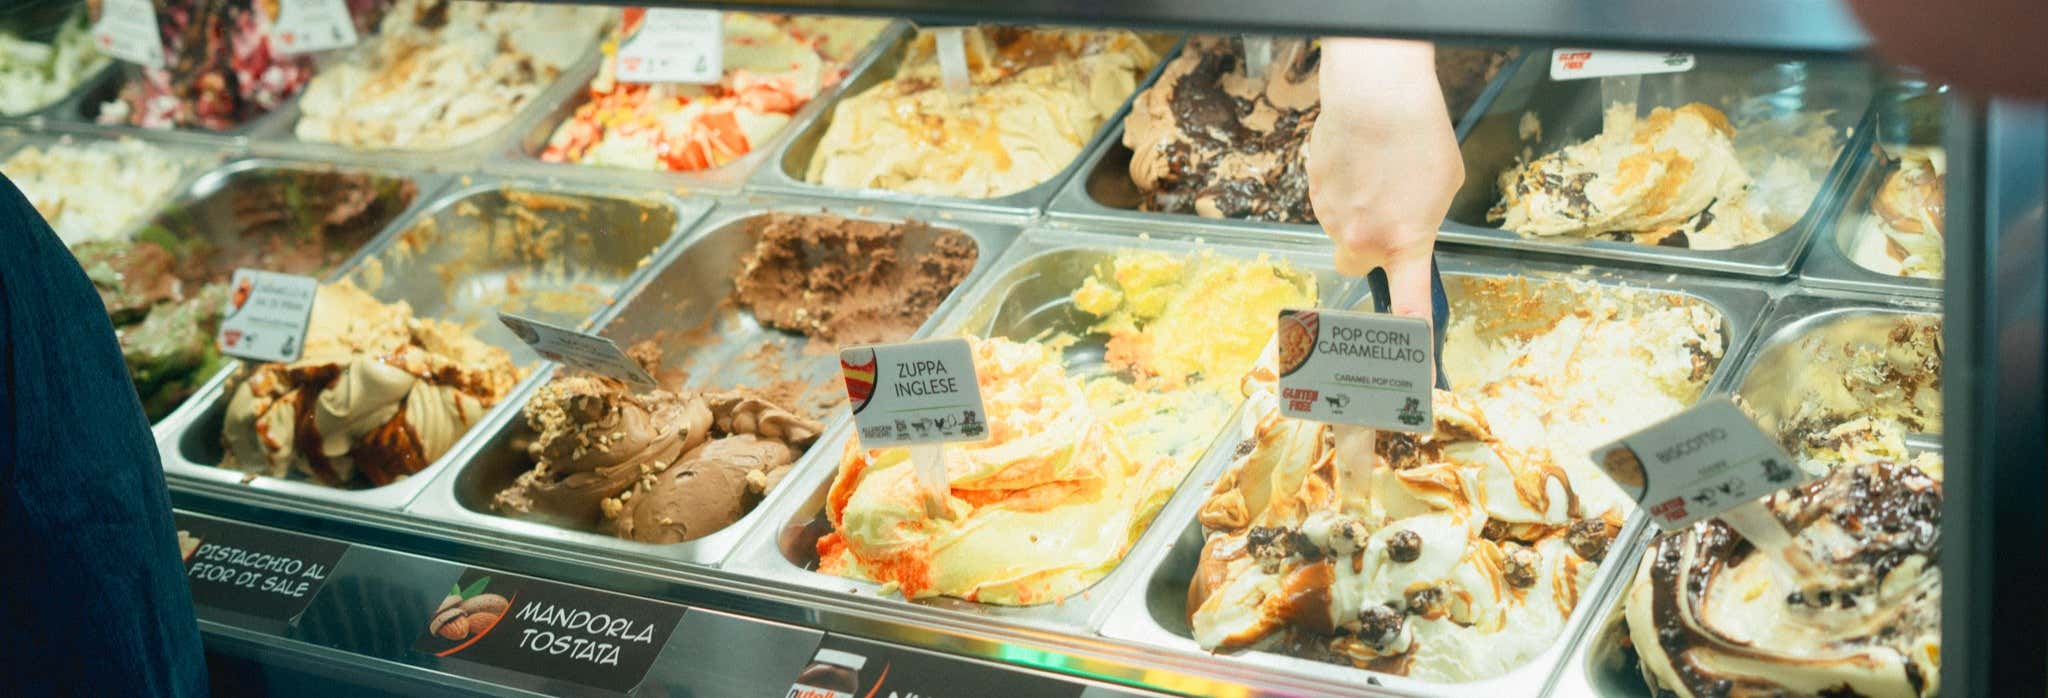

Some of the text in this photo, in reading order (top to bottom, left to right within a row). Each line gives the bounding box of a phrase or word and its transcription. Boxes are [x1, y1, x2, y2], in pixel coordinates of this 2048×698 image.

[1332, 326, 1410, 346] POP CORN
[1318, 340, 1425, 364] CARAMELLATO
[897, 360, 947, 378] ZUPPA
[894, 377, 959, 397] INGLESE
[1334, 373, 1370, 384] CARAMEL
[1371, 377, 1388, 386] POP
[1282, 387, 1319, 402] GLUTEN
[1288, 400, 1312, 413] FREE
[195, 543, 325, 580] PISTACCHIO AL
[188, 562, 310, 598] FIOR DI SALE
[515, 601, 654, 643] MANDORLA
[519, 628, 620, 666] TOSTATA
